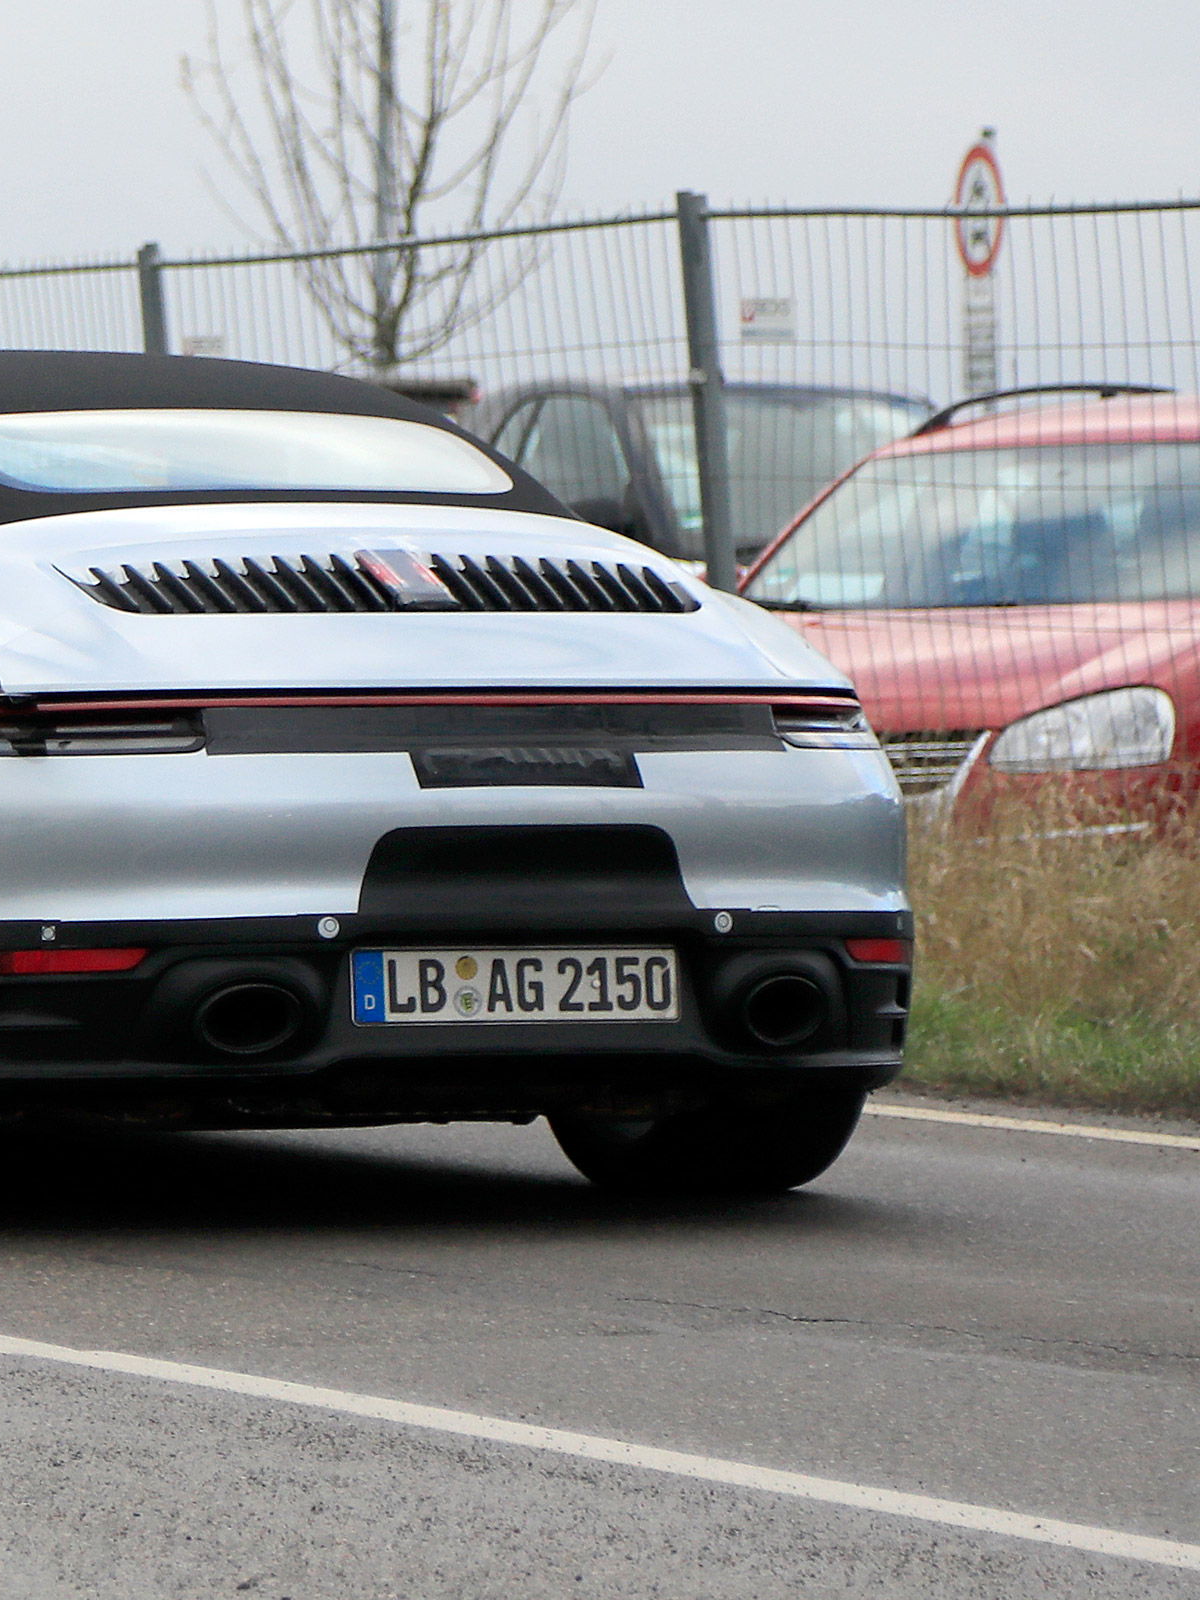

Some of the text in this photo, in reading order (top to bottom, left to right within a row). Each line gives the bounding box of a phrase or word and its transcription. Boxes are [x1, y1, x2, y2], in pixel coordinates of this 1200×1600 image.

[364, 994, 376, 1010] D
[388, 957, 671, 1013] LB AG 2150
